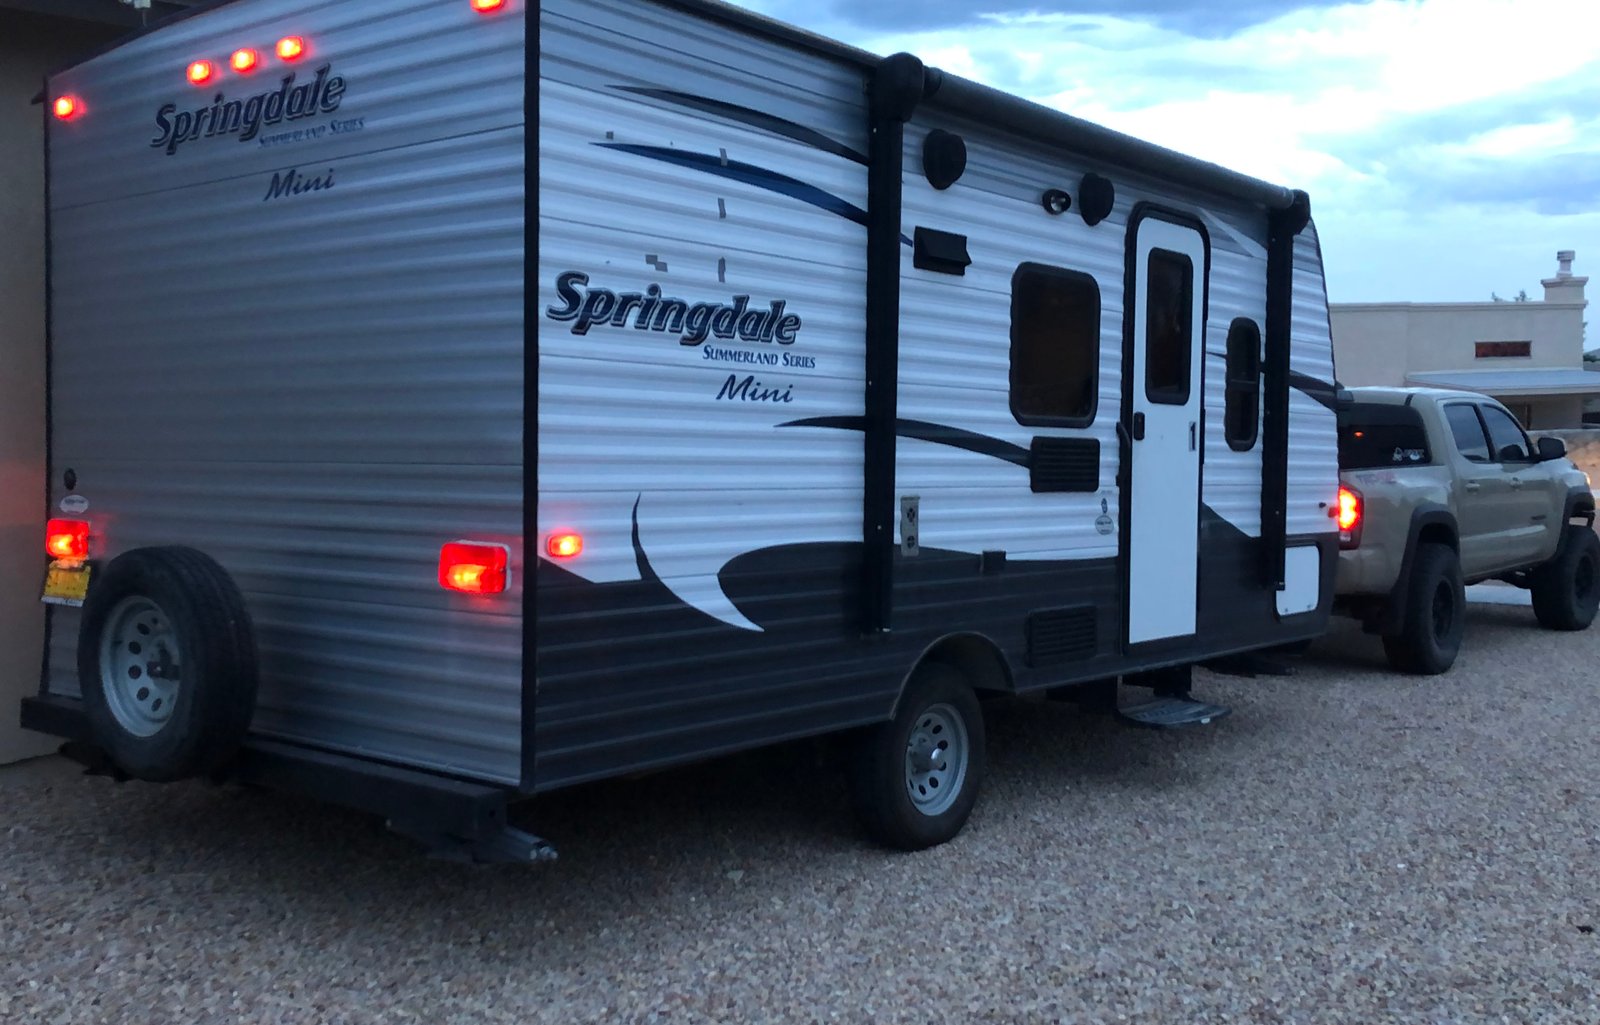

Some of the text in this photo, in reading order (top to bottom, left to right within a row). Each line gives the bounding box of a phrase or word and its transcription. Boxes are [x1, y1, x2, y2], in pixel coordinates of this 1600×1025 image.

[150, 63, 346, 155] Springdale
[262, 168, 336, 201] Mini
[546, 270, 802, 346] Springdale
[703, 345, 816, 369] SUMMERLAND SERIES
[716, 374, 794, 403] Mini
